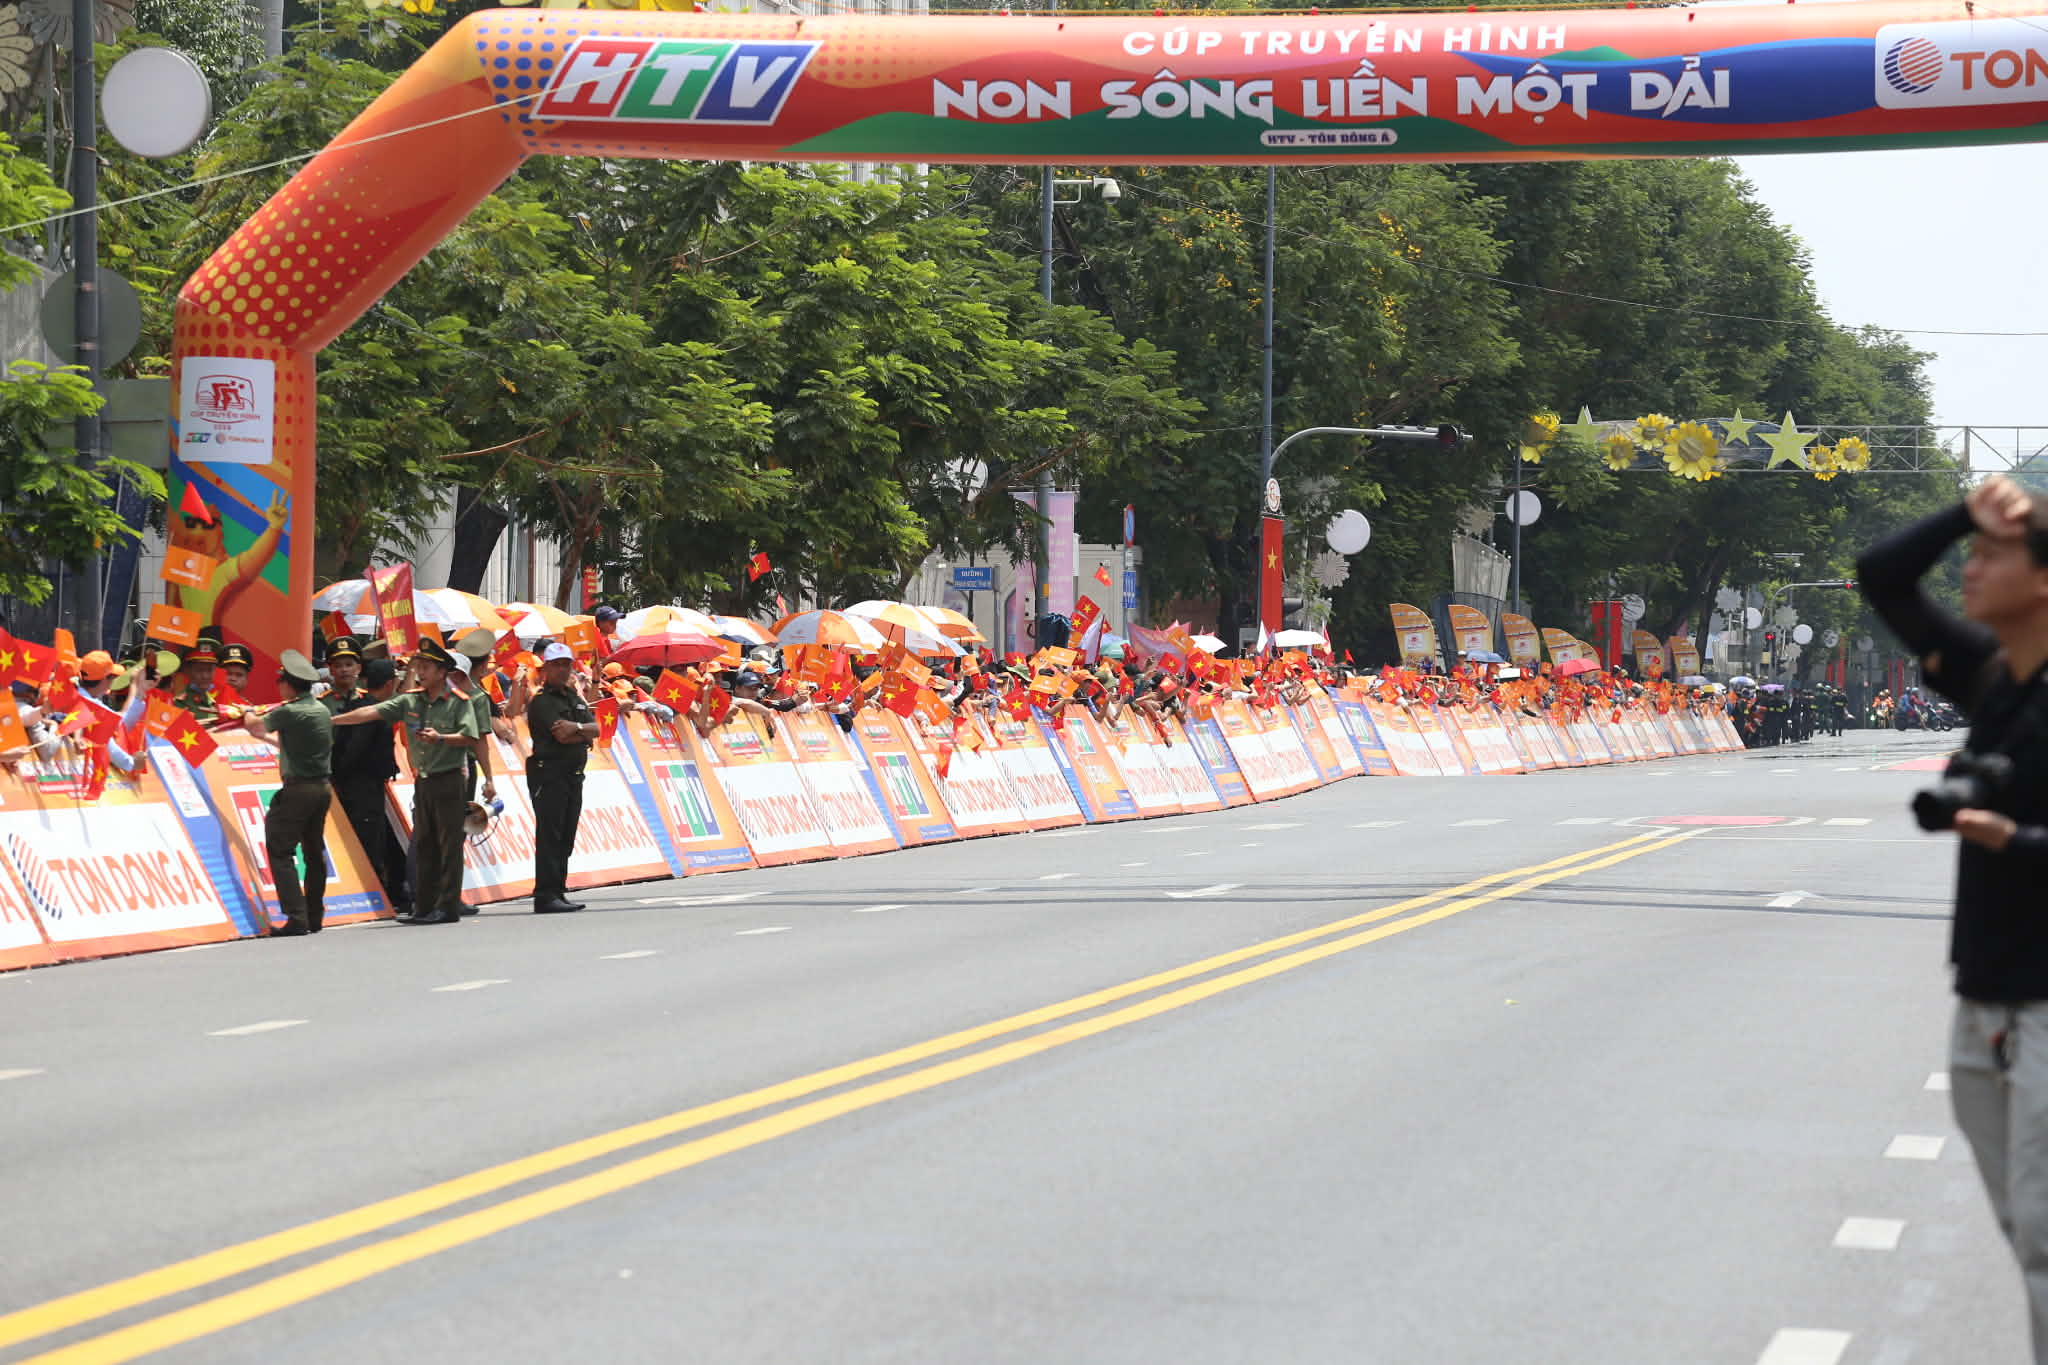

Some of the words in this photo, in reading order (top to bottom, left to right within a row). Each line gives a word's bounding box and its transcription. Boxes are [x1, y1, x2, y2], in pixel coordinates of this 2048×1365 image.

[1122, 26, 1222, 56] CÚP
[1442, 22, 1566, 52] HÌNH
[551, 51, 797, 109] HTV
[933, 78, 1071, 120] NON
[1100, 68, 1274, 126] SÔNG
[1302, 58, 1428, 118] LIỀN
[1456, 62, 1597, 124] MỘT
[1629, 55, 1730, 119] DẢI
[1267, 134, 1296, 144] HTV
